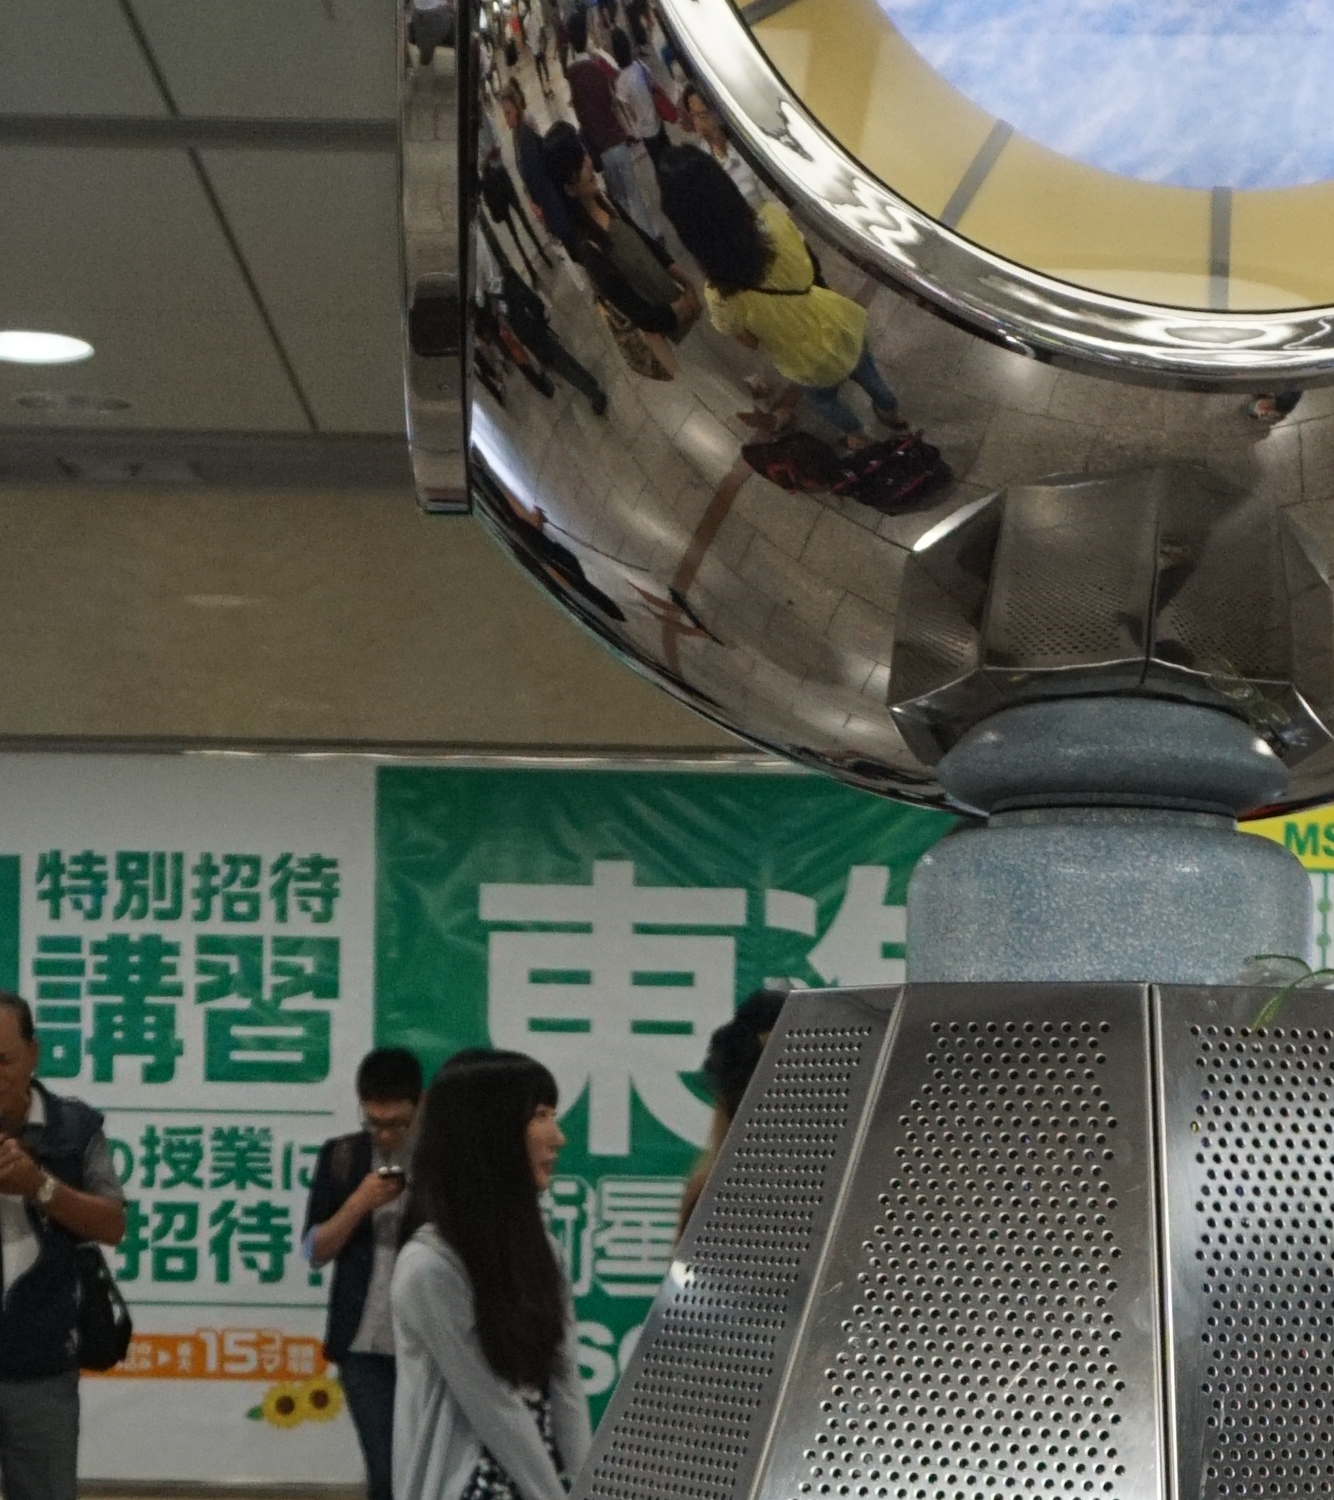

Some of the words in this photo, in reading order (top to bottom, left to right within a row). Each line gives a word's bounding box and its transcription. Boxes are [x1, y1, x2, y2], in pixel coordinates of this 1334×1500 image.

[35, 849, 340, 924] 特別招待
[32, 932, 342, 1084] 講習
